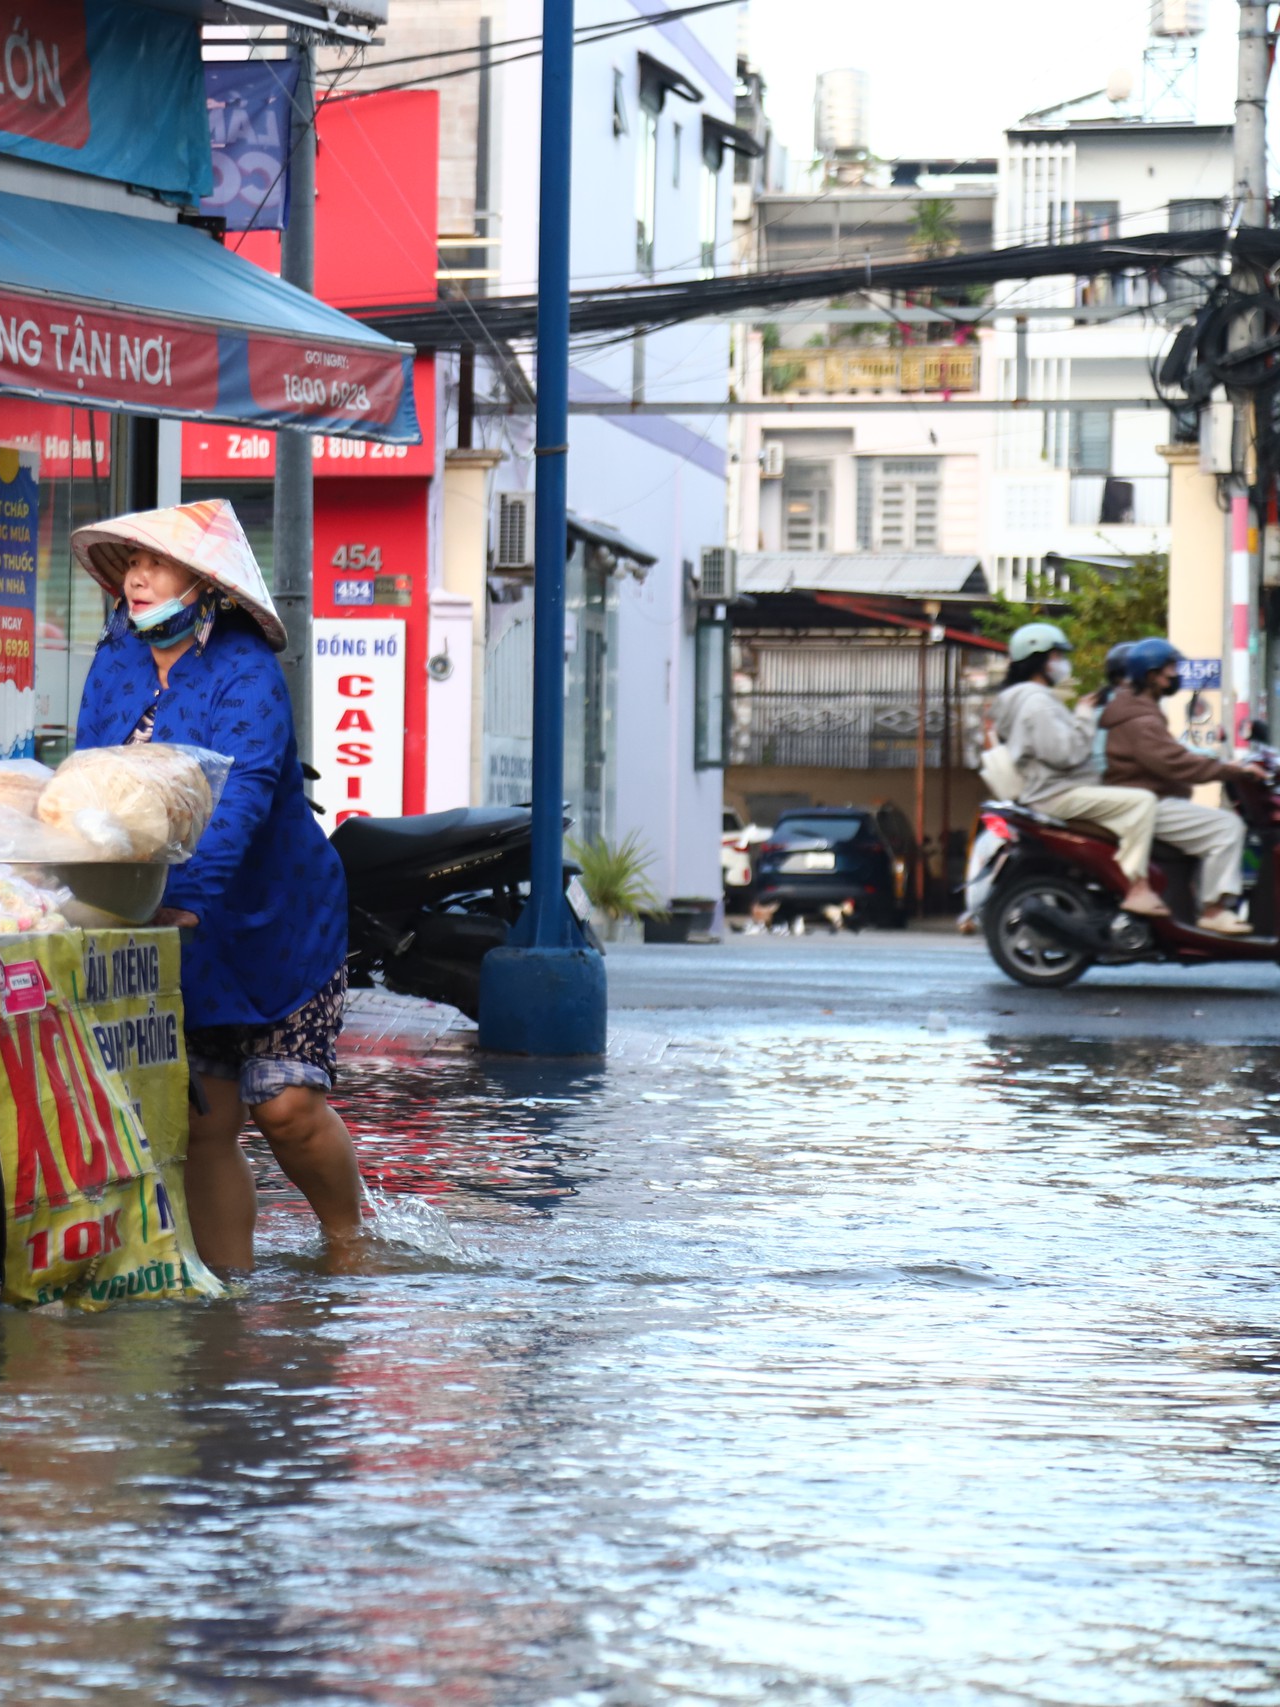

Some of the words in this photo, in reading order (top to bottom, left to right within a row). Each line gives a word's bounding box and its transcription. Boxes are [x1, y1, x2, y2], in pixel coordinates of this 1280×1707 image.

[49, 314, 112, 389] TẬN
[119, 335, 172, 387] NƠI
[305, 350, 322, 368] GỌI
[323, 354, 349, 369] NGAY:
[283, 373, 326, 406] 1800
[331, 381, 371, 411] 6928
[227, 434, 270, 458] Zalo
[4, 497, 29, 518] CHẤP
[3, 550, 34, 572] THUỐC
[331, 543, 383, 572] 454
[6, 575, 26, 595] NHÀ
[337, 582, 371, 598] 454
[2, 616, 23, 631] NGAY
[5, 638, 30, 658] 6928
[112, 938, 159, 998] RIÊNG
[27, 1208, 122, 1271] 10K
